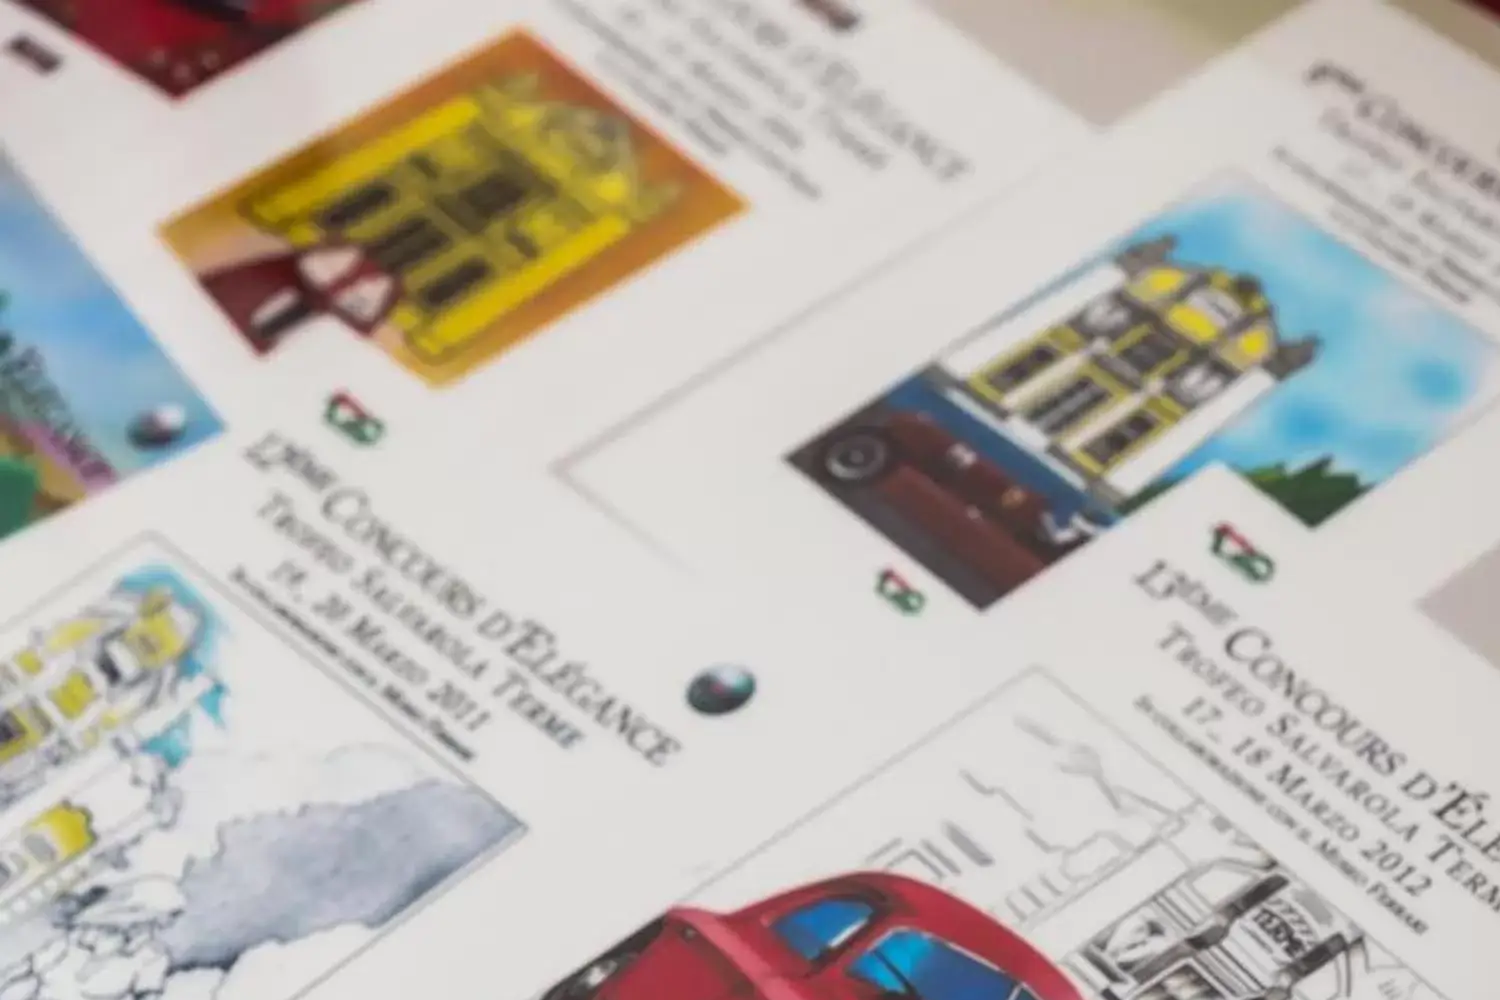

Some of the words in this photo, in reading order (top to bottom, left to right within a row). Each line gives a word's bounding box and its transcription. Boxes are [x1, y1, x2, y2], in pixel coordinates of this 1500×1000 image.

[1223, 628, 1407, 776] CONCOURS
[1266, 713, 1420, 843] SALVAROLA
[1267, 763, 1360, 841] MARZO
[1360, 840, 1432, 897] 2012
